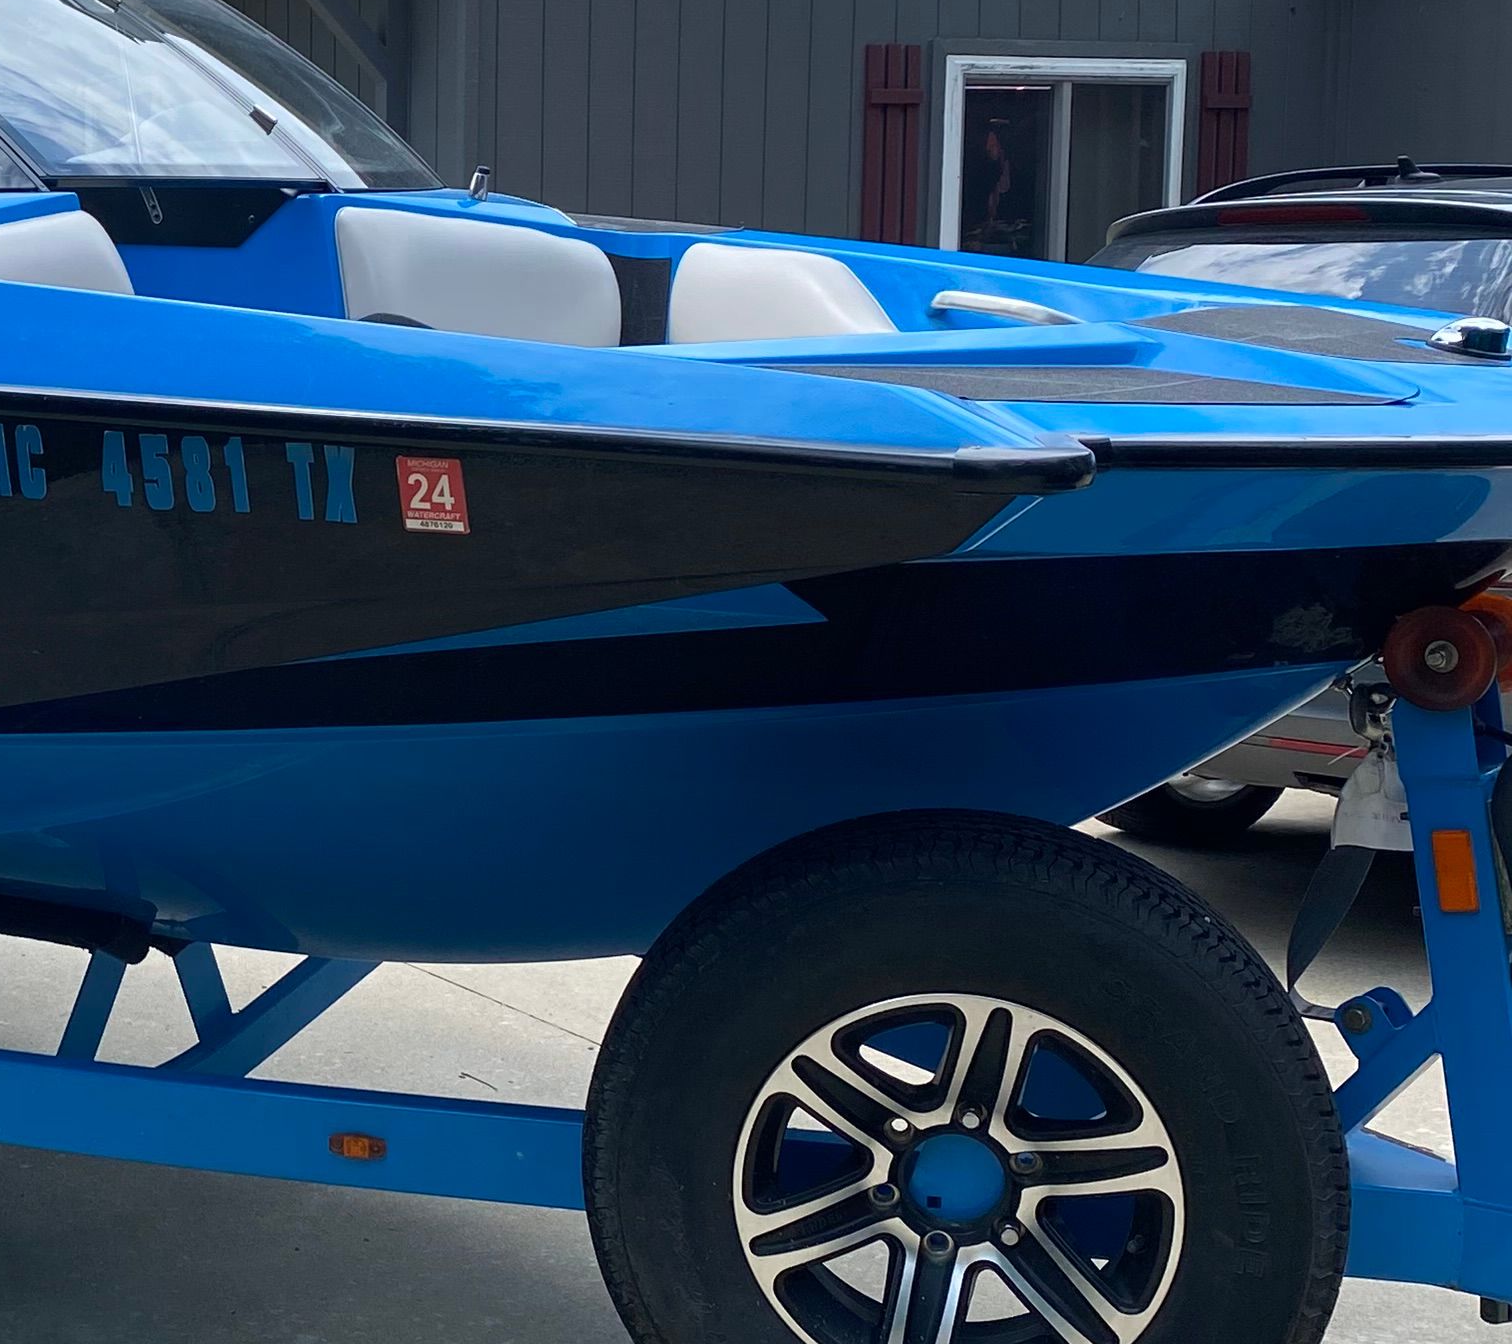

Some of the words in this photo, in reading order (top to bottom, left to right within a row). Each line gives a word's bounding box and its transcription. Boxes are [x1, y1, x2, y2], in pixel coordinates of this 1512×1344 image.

[102, 431, 251, 513] 4581
[285, 442, 358, 523] TX
[408, 473, 455, 510] 24
[407, 511, 461, 520] WATERCRAFT
